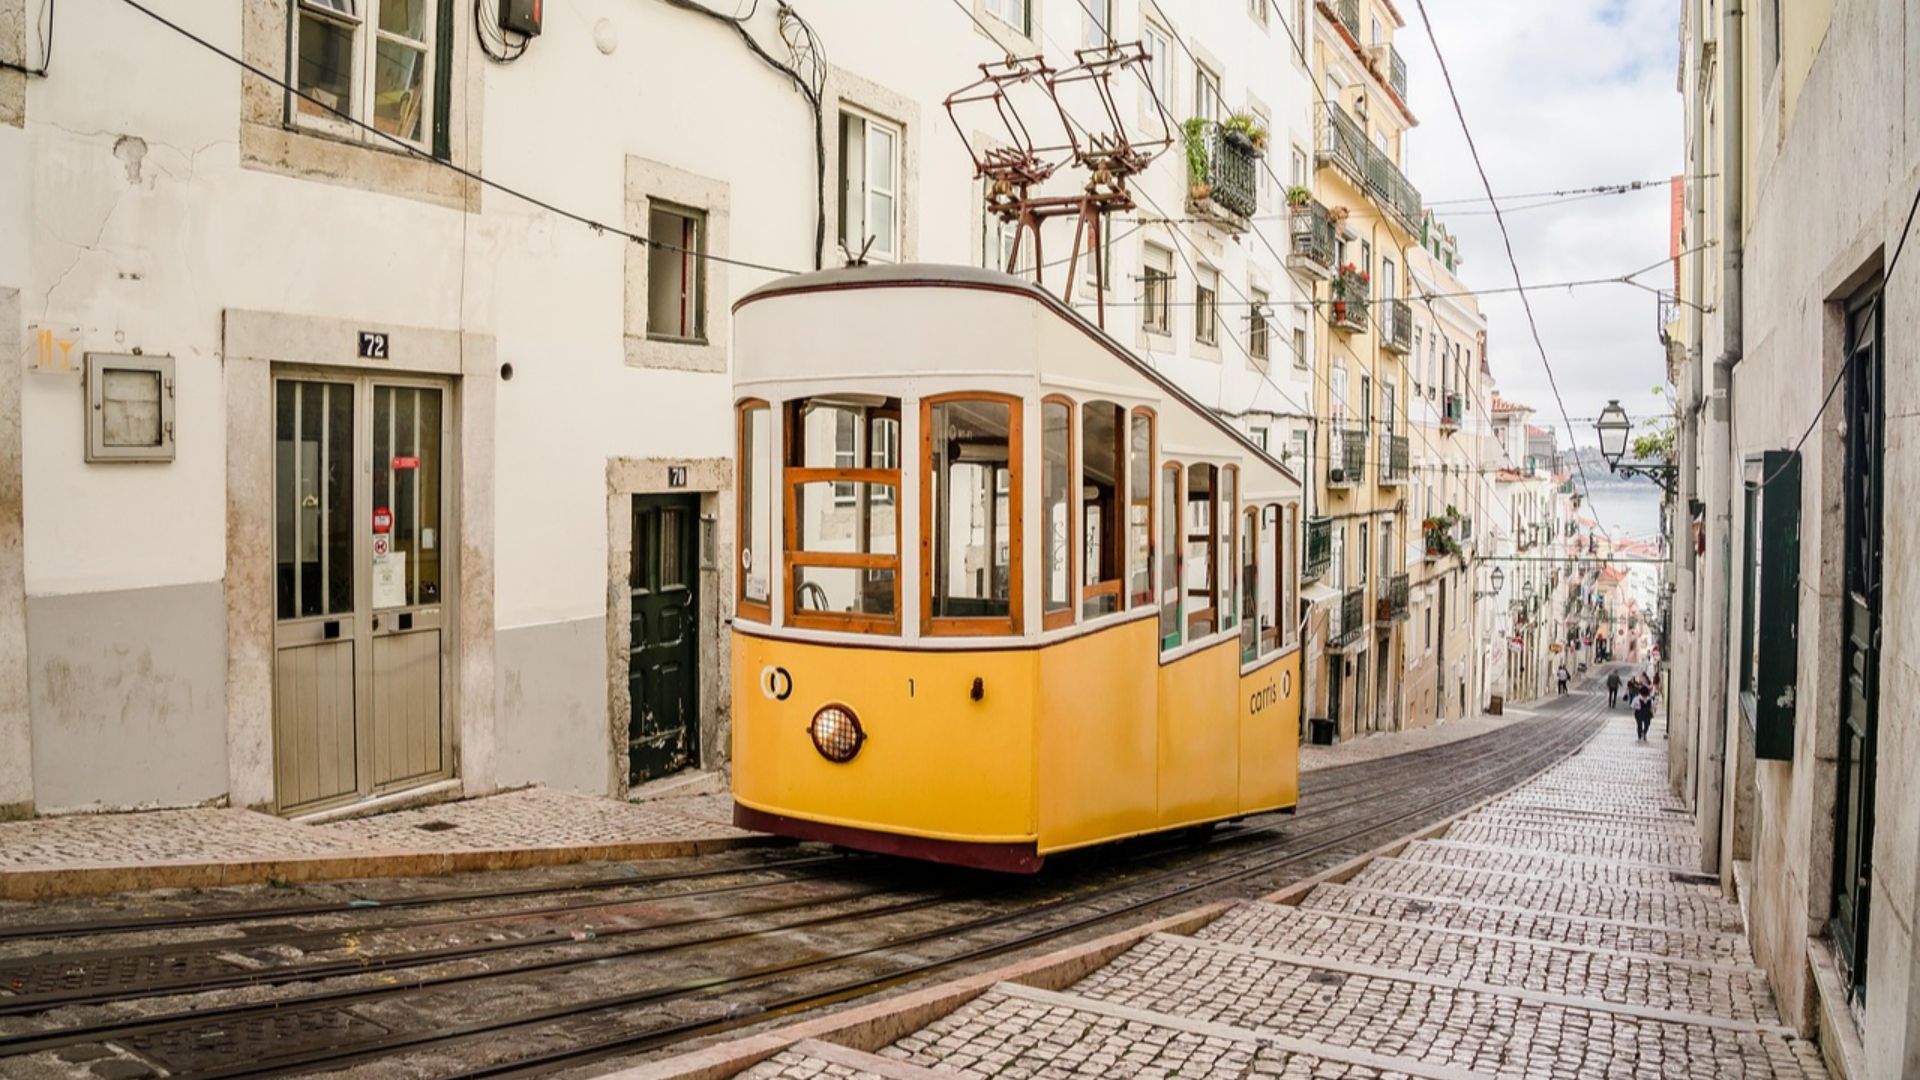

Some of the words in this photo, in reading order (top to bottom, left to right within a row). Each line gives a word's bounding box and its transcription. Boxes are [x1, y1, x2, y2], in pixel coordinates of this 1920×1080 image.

[364, 333, 384, 357] 72
[672, 468, 685, 486] 70
[1250, 676, 1277, 715] carris
